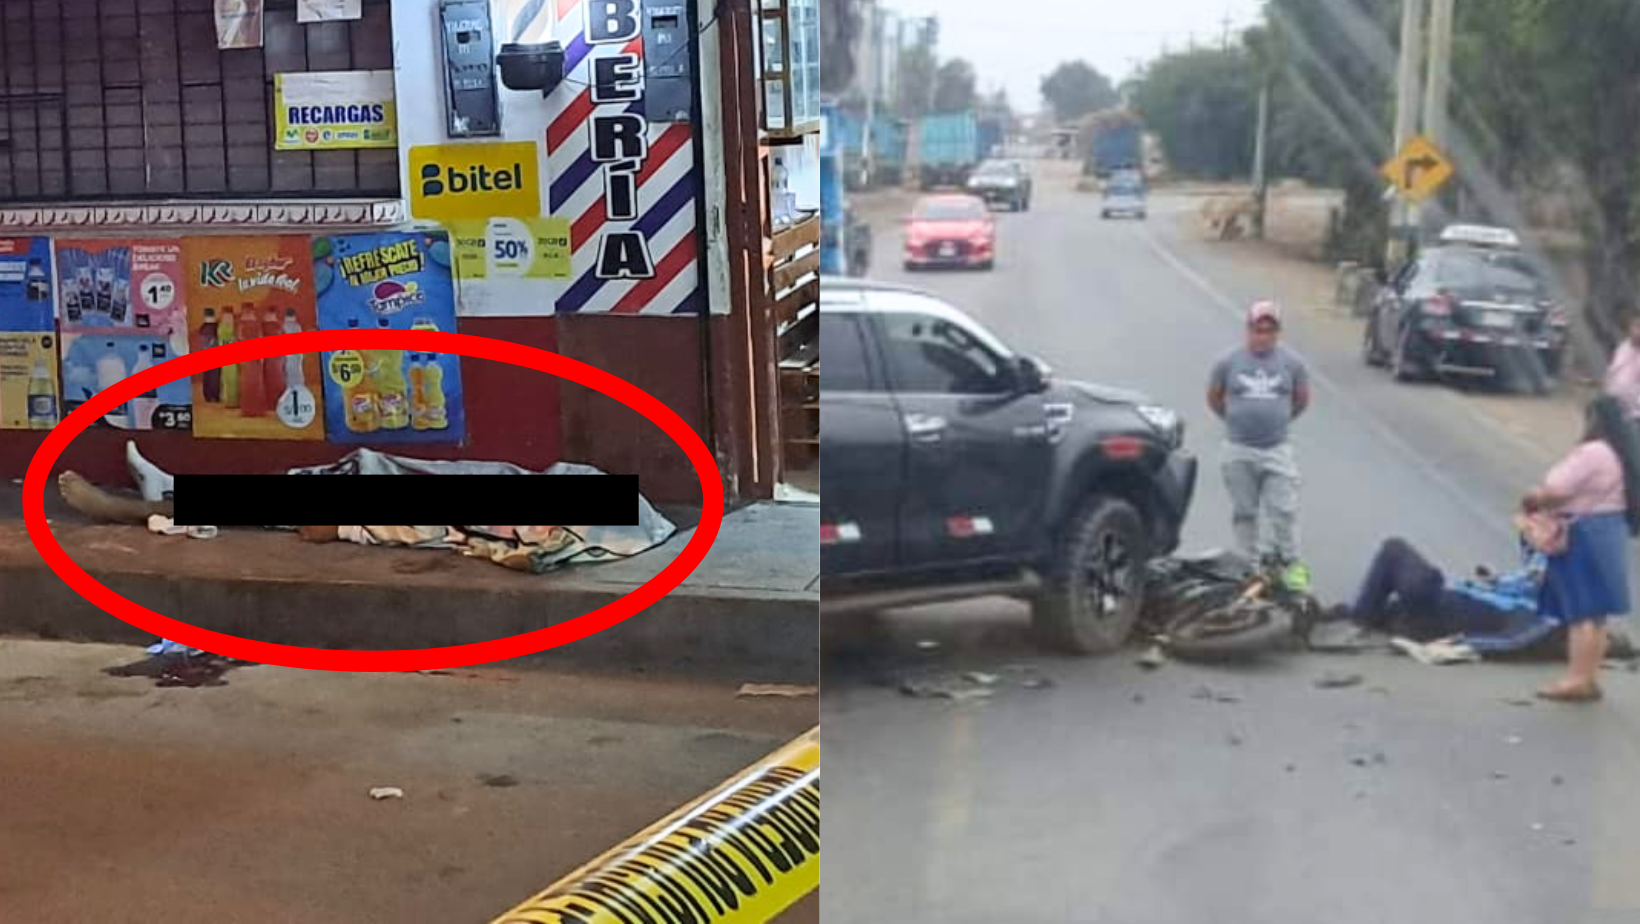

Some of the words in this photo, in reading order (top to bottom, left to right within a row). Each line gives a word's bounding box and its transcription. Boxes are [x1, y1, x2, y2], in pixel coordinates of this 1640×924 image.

[288, 104, 384, 124] RECARGAS
[447, 163, 522, 192] bitel
[494, 240, 528, 259] 50%
[200, 260, 233, 286] KR
